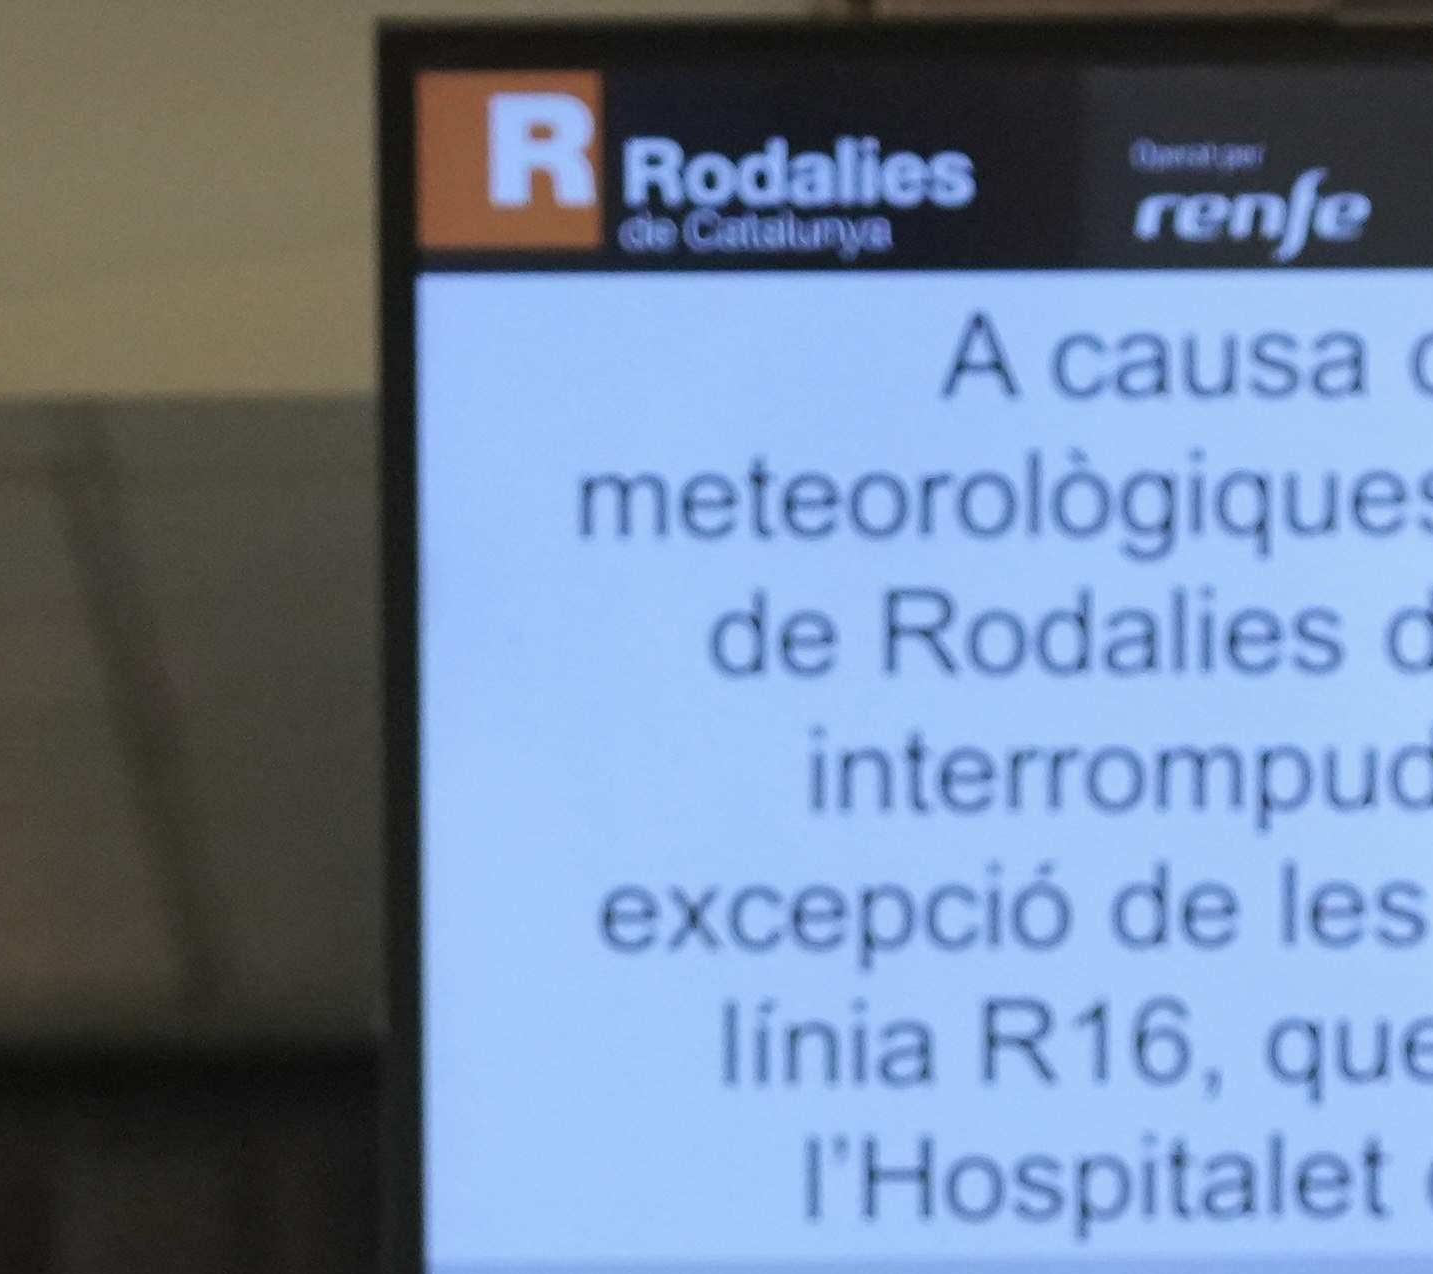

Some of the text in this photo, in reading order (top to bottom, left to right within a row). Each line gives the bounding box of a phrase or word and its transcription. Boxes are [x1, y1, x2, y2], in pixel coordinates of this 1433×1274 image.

[488, 92, 596, 208] R
[621, 134, 979, 210] Rodalies
[617, 205, 895, 263] de Catalunya
[1132, 165, 1373, 263] renfe
[938, 309, 1023, 402] A
[1048, 329, 1370, 403] causa
[706, 587, 841, 681] de
[880, 584, 1347, 680] Rodalies
[596, 860, 1075, 974] excepció
[1108, 860, 1242, 953] de
[1279, 859, 1430, 952] les
[721, 997, 937, 1091] línia
[978, 994, 1223, 1098] R16,
[803, 1131, 1391, 1242] l’Hospitalet
